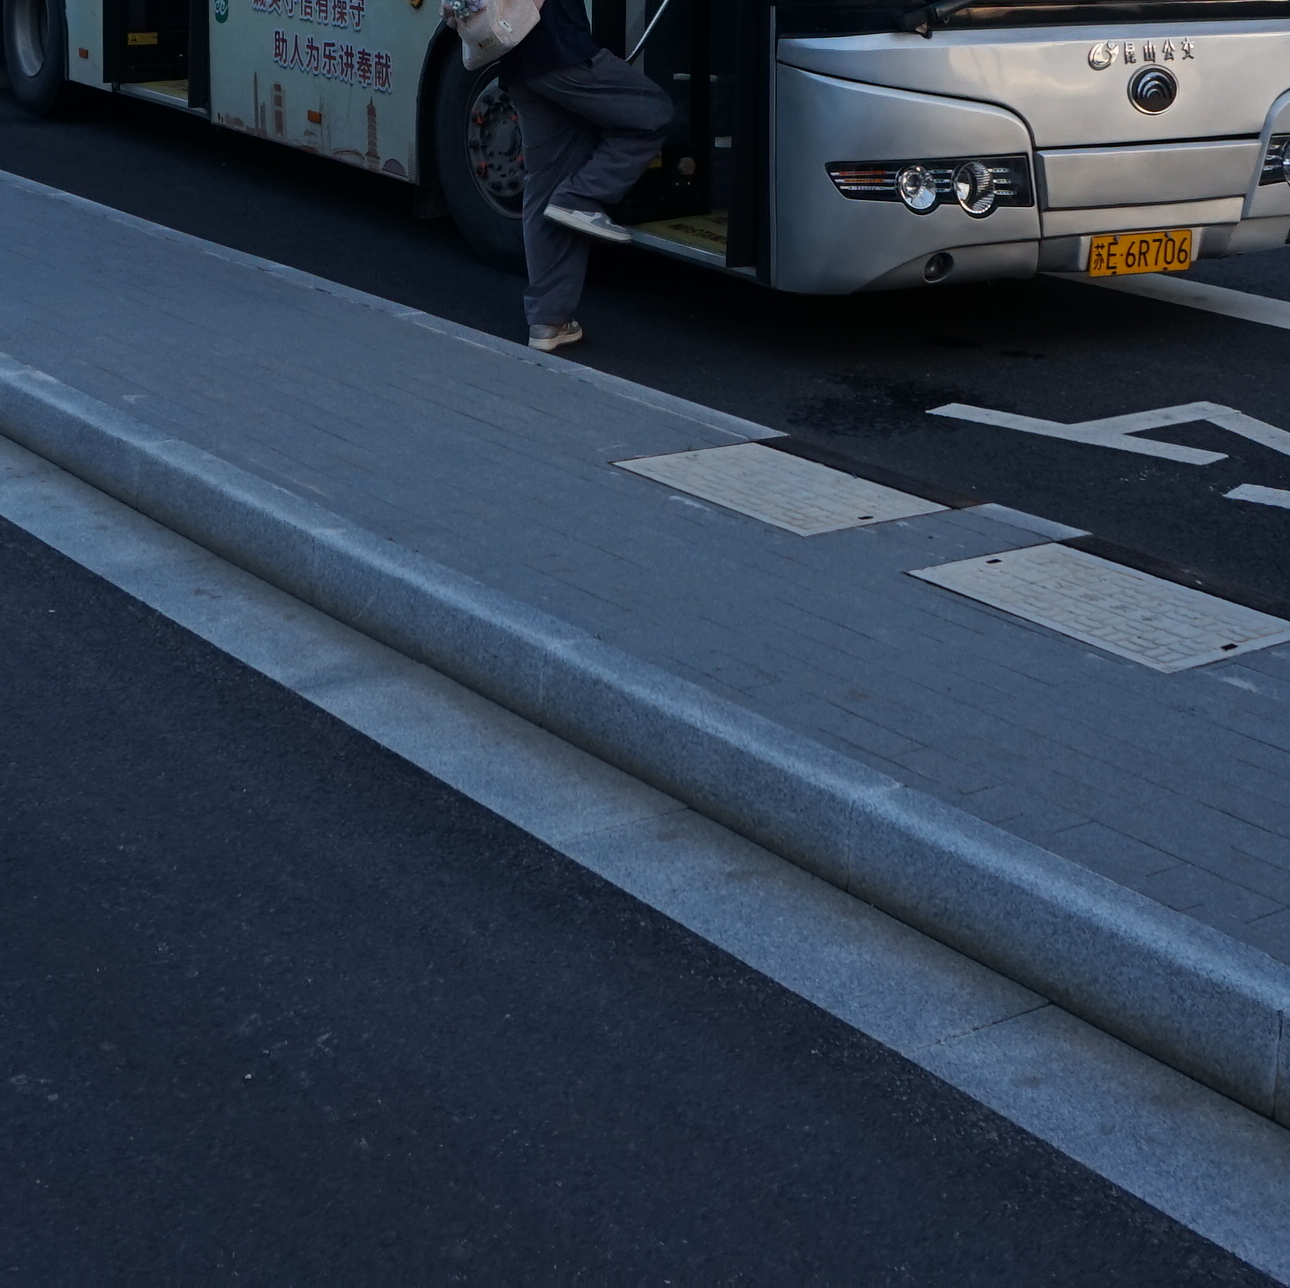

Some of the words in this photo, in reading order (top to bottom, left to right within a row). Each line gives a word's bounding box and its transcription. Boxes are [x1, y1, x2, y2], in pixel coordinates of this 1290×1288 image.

[273, 30, 392, 93] 助人为乐讲奉献
[1124, 38, 1194, 64] 昆山公交
